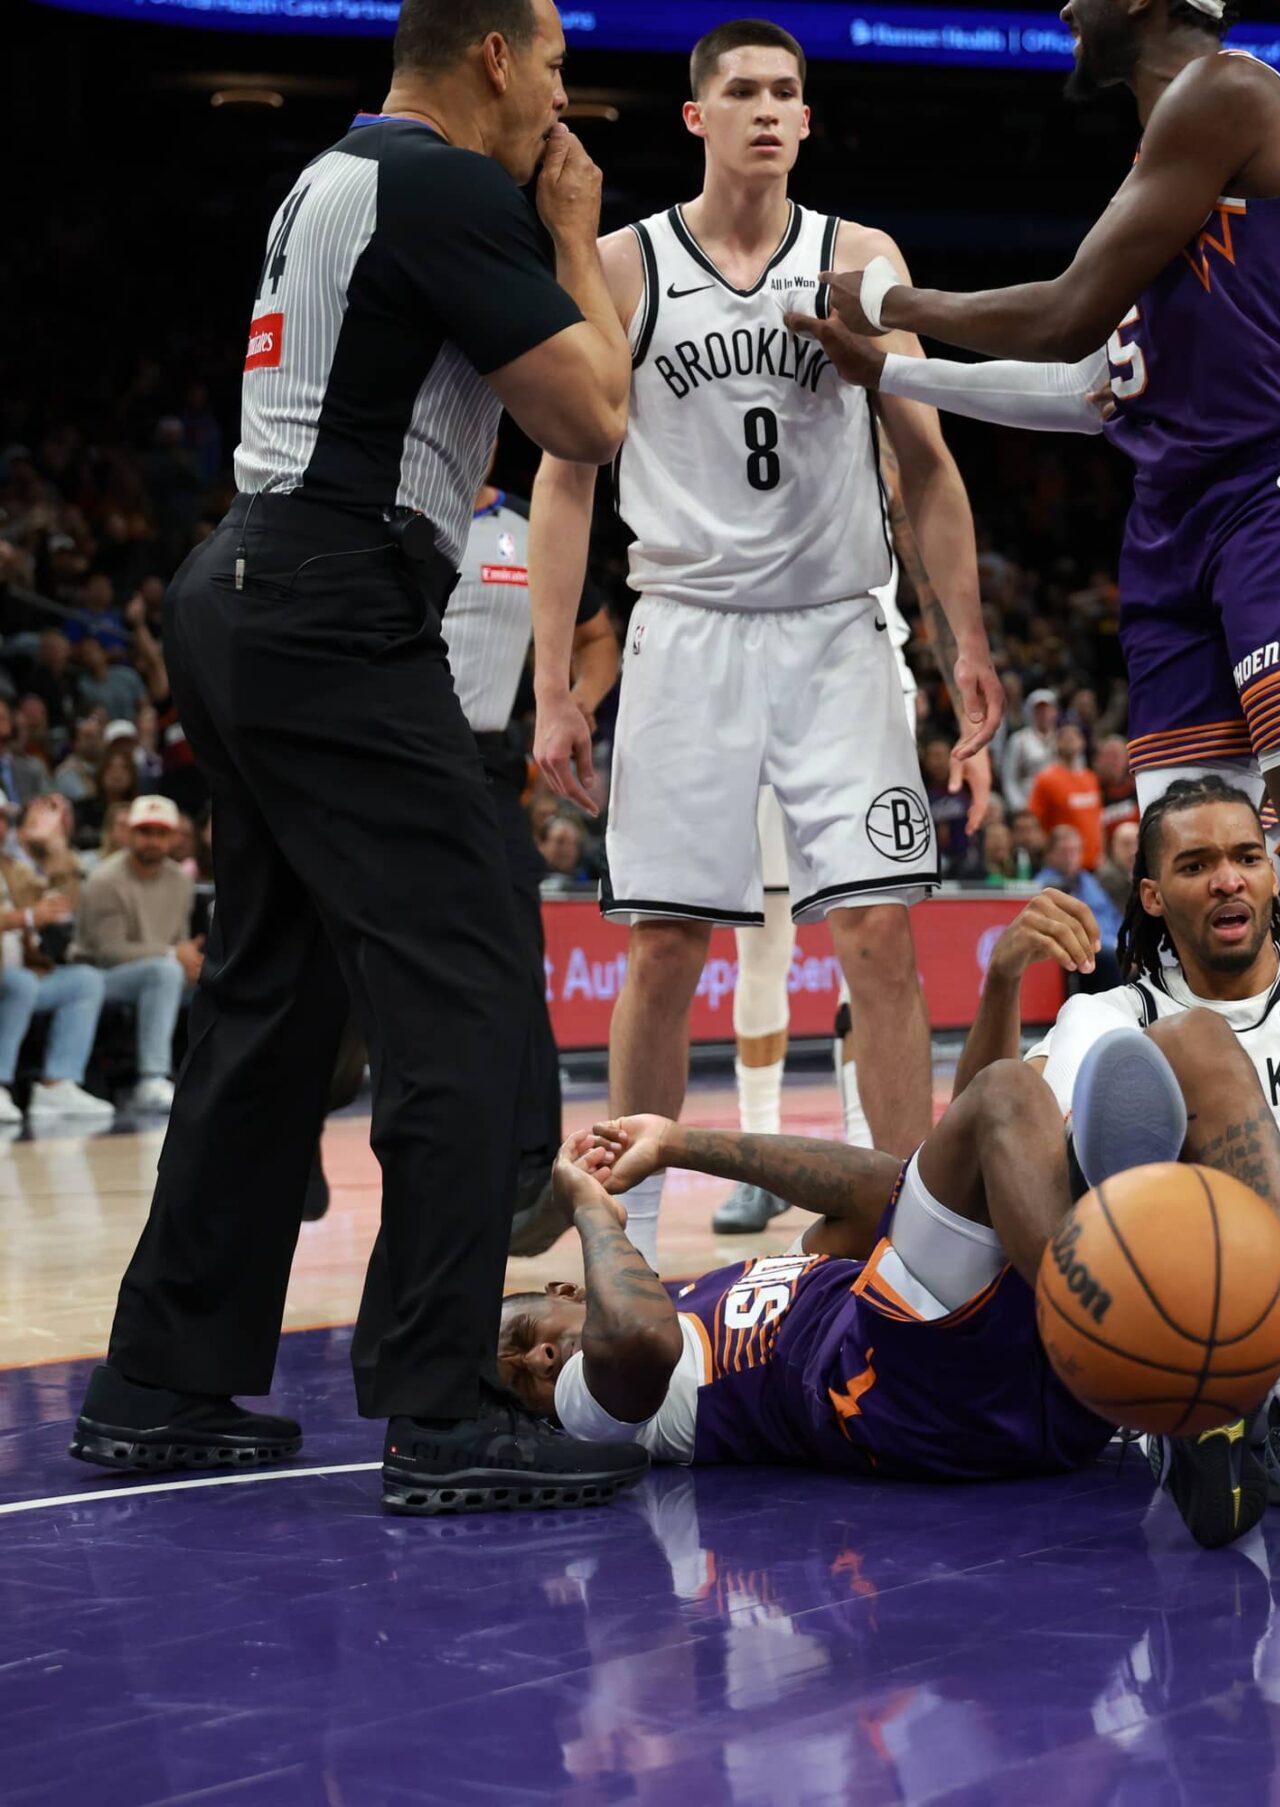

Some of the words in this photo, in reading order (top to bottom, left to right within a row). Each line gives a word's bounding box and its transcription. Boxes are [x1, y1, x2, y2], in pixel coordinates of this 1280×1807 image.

[771, 278, 783, 290] All
[784, 278, 793, 289] In
[794, 276, 816, 288] Won
[654, 327, 833, 400] BROOKLYN
[743, 406, 780, 490] 8
[891, 798, 915, 851] B
[562, 947, 628, 1001] Aut
